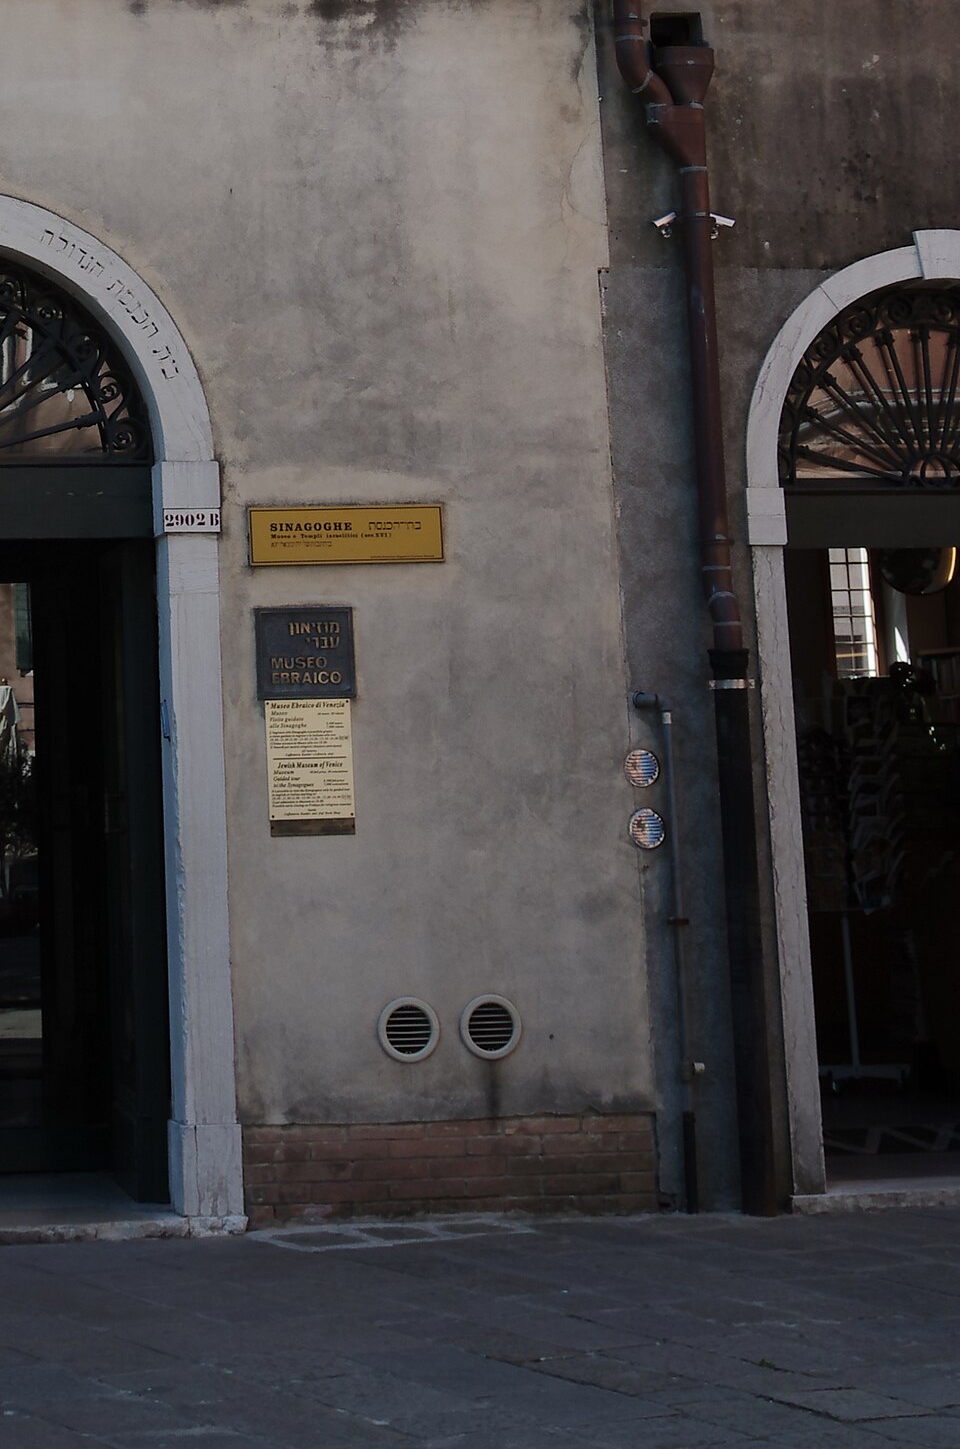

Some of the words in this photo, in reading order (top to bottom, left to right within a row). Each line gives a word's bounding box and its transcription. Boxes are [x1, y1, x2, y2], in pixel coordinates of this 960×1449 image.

[165, 513, 205, 527] 2902
[210, 513, 219, 526] B
[270, 522, 352, 532] SINAGOGHE
[289, 622, 339, 636] מוזיאון
[305, 637, 340, 648] עברי
[271, 657, 327, 669] MUSEO
[272, 671, 342, 684] EBRAICO
